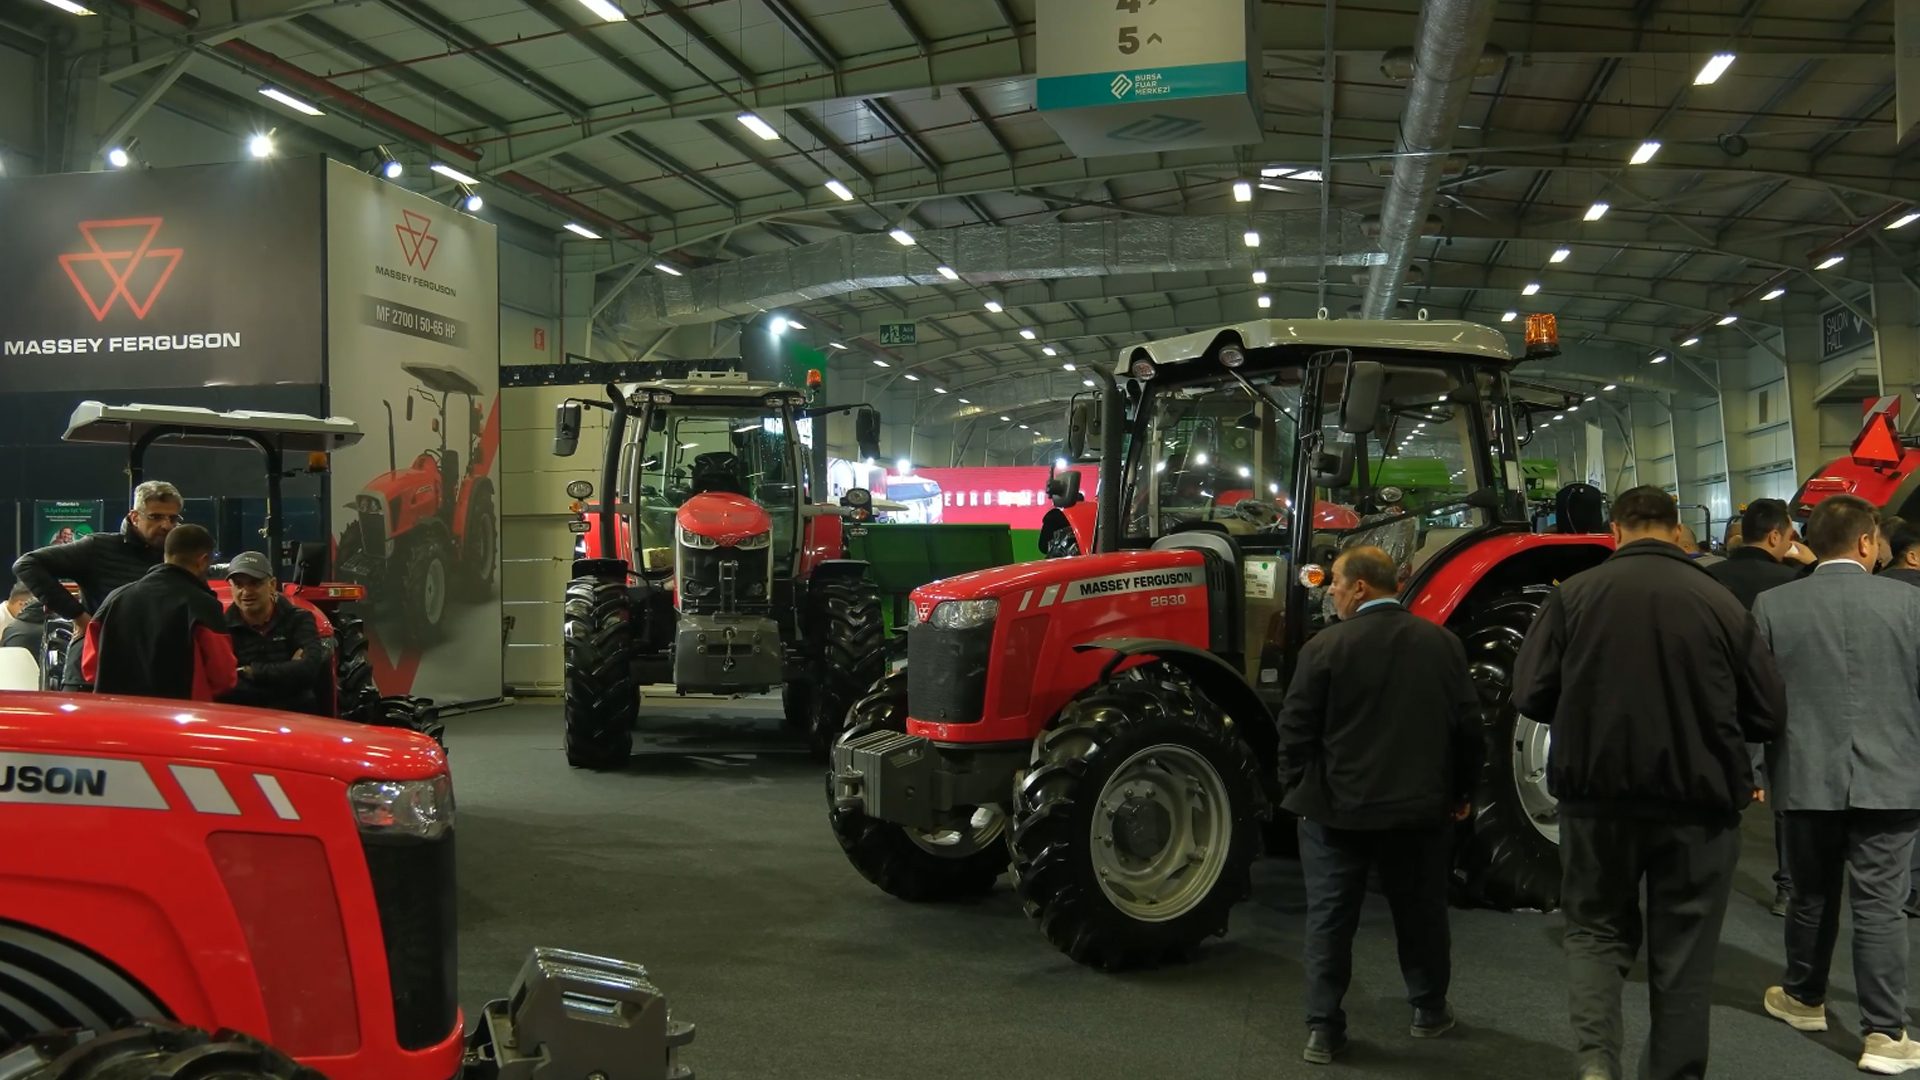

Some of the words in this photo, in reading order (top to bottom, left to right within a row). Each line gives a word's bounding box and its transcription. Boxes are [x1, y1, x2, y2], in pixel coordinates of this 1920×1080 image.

[1118, 26, 1140, 55] 5
[1135, 73, 1162, 82] BURSA
[1135, 80, 1158, 89] FUAR
[375, 265, 411, 284] MASSEY
[413, 276, 457, 297] FERGUSON
[376, 305, 390, 323] MF
[392, 309, 413, 329] 2700
[445, 323, 456, 339] HP
[4, 338, 103, 356] MASSEY
[109, 332, 241, 352] FERGUSON
[1080, 578, 1130, 596] MASSEY
[1134, 572, 1192, 588] FERGUSON
[1150, 594, 1186, 607] 2630
